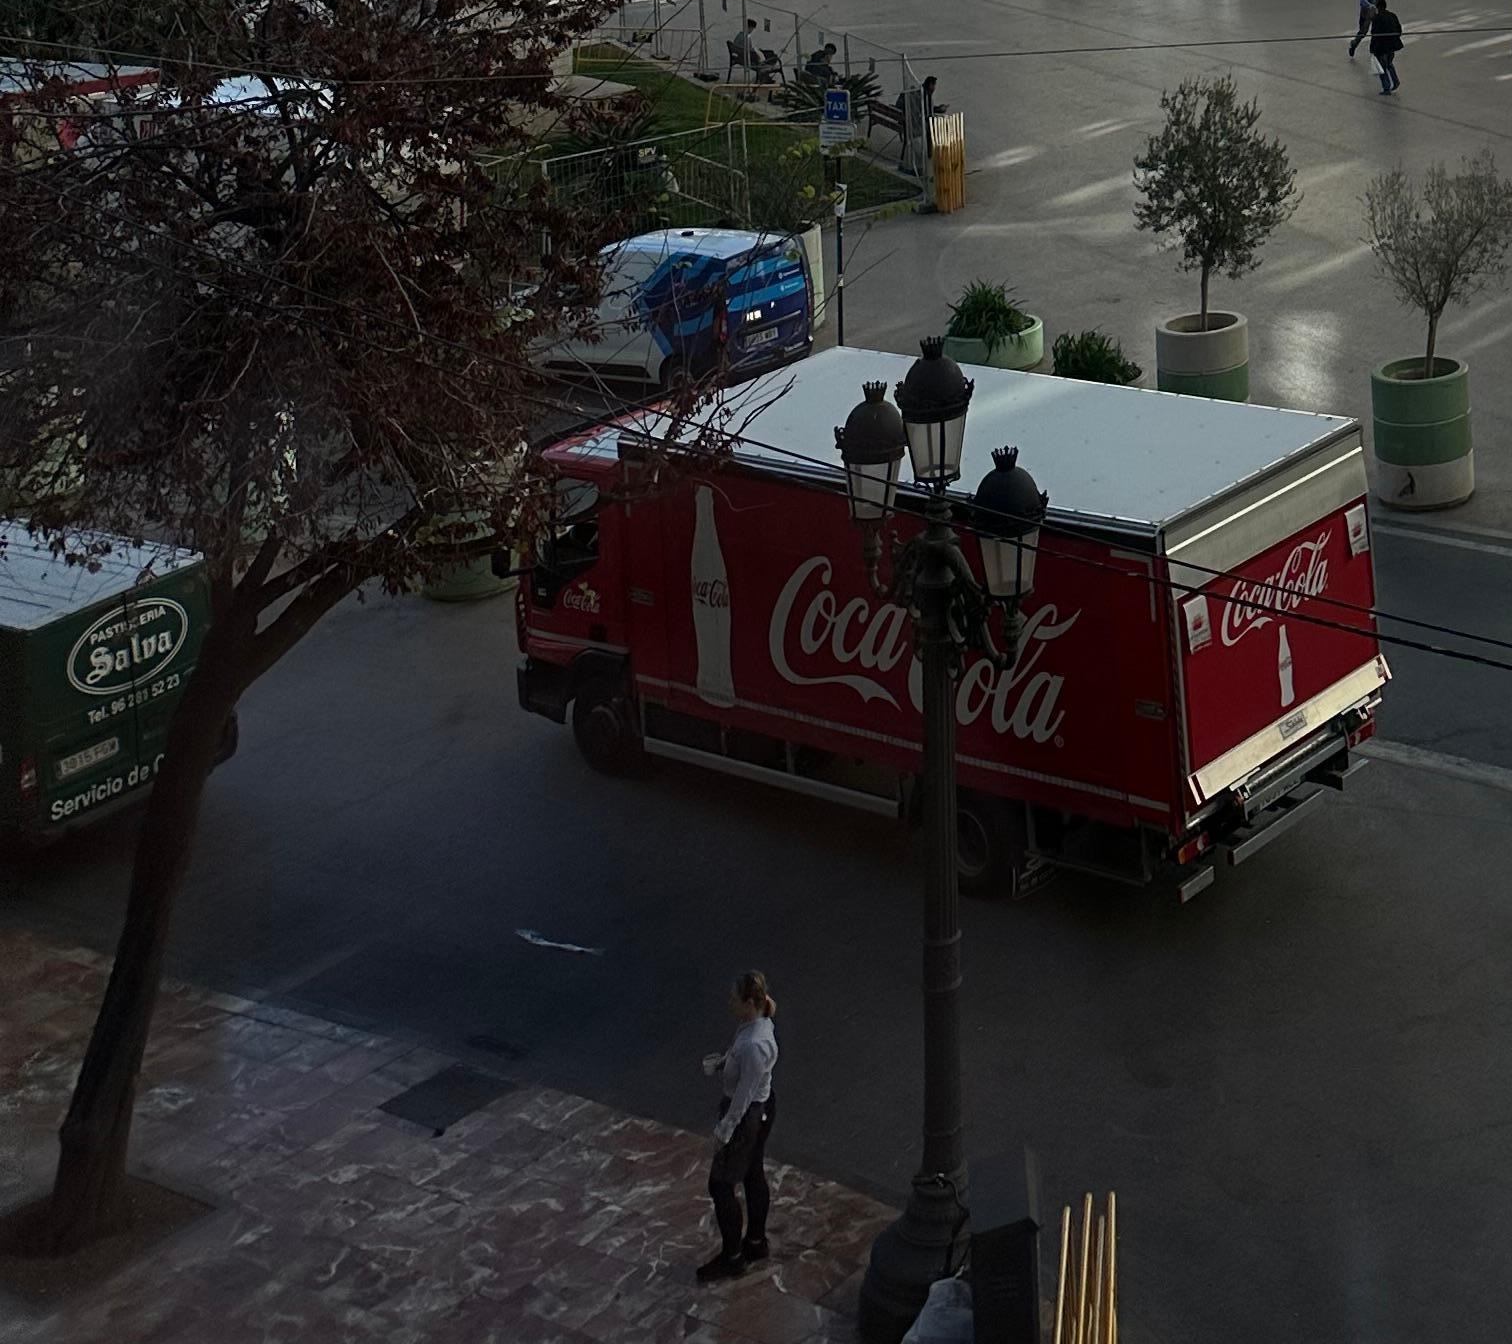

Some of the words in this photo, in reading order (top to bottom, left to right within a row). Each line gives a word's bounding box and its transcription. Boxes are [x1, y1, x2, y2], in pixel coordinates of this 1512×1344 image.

[826, 99, 847, 112] TAXI
[86, 630, 174, 685] Salva
[769, 555, 1082, 744] Cocaola
[88, 708, 110, 725] Tel.
[51, 777, 124, 822] Servicio
[127, 764, 151, 788] de
